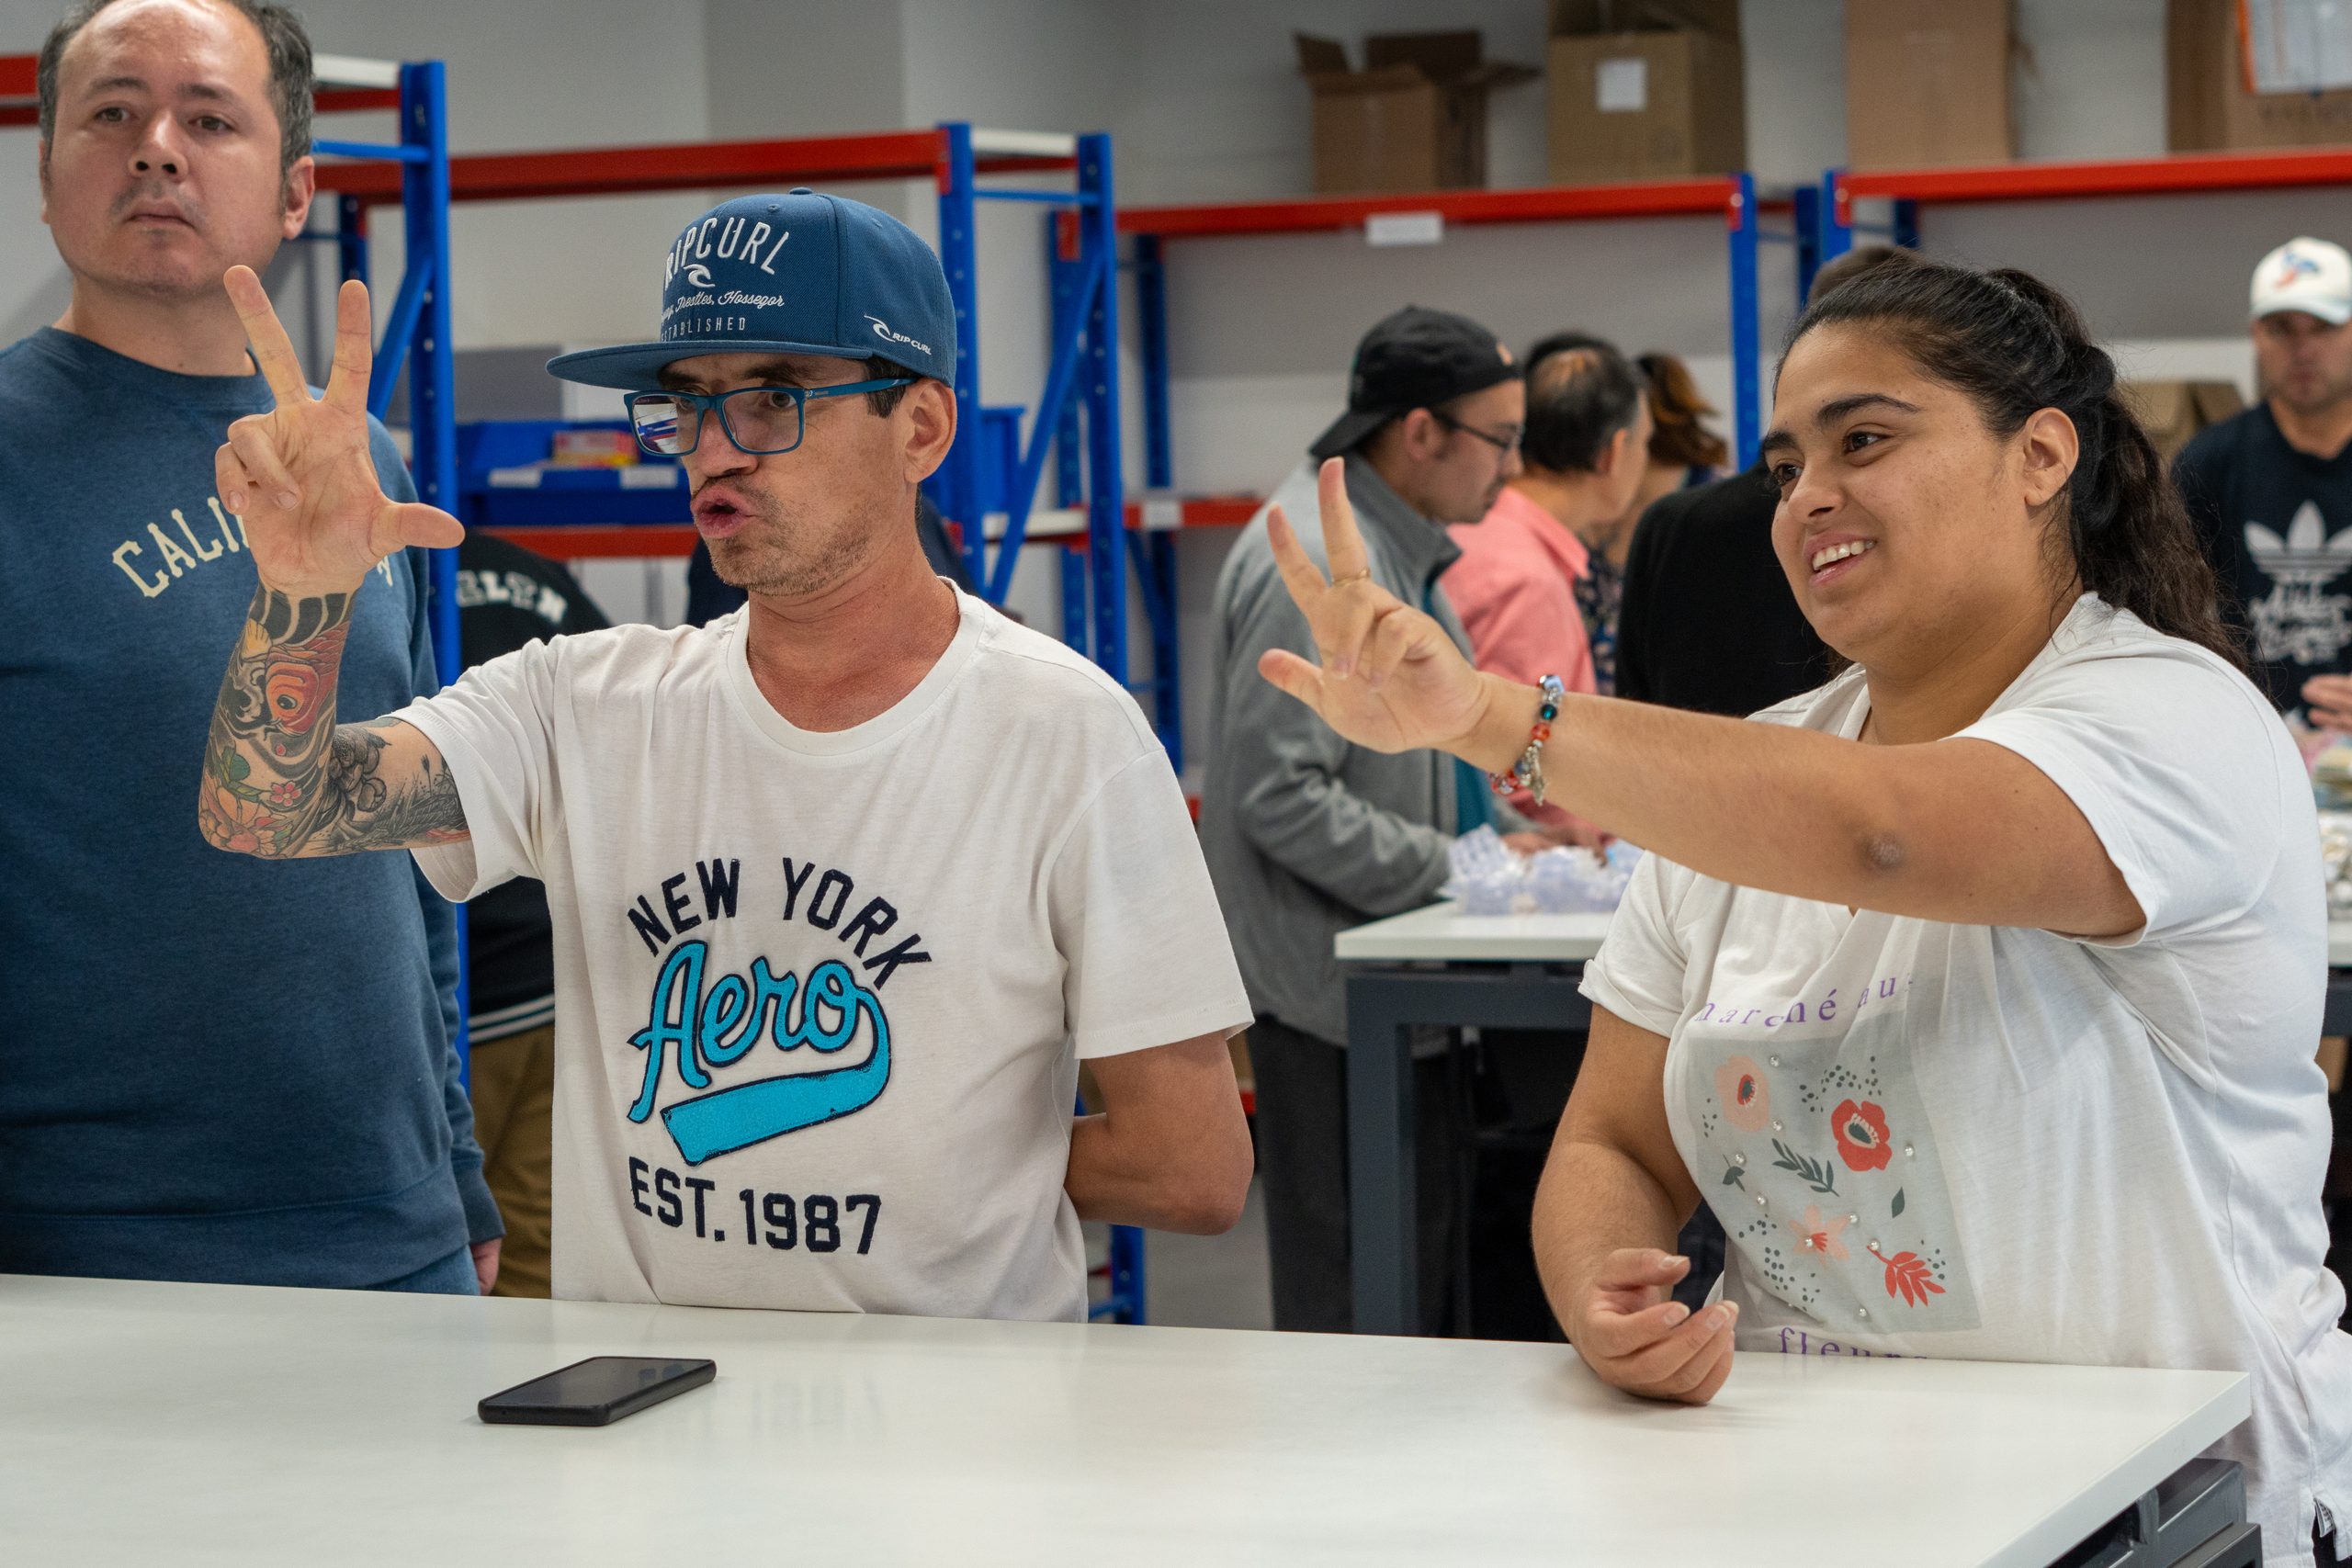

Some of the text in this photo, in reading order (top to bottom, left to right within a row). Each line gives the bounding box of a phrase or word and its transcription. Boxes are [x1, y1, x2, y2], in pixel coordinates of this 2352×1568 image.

[718, 290, 786, 310] Hossegor
[892, 332, 932, 355] RIP CURL
[627, 857, 933, 991] NEW YORK
[1857, 974, 1914, 1010] au
[627, 939, 892, 1123] Aero
[628, 1156, 882, 1255] EST. 1987
